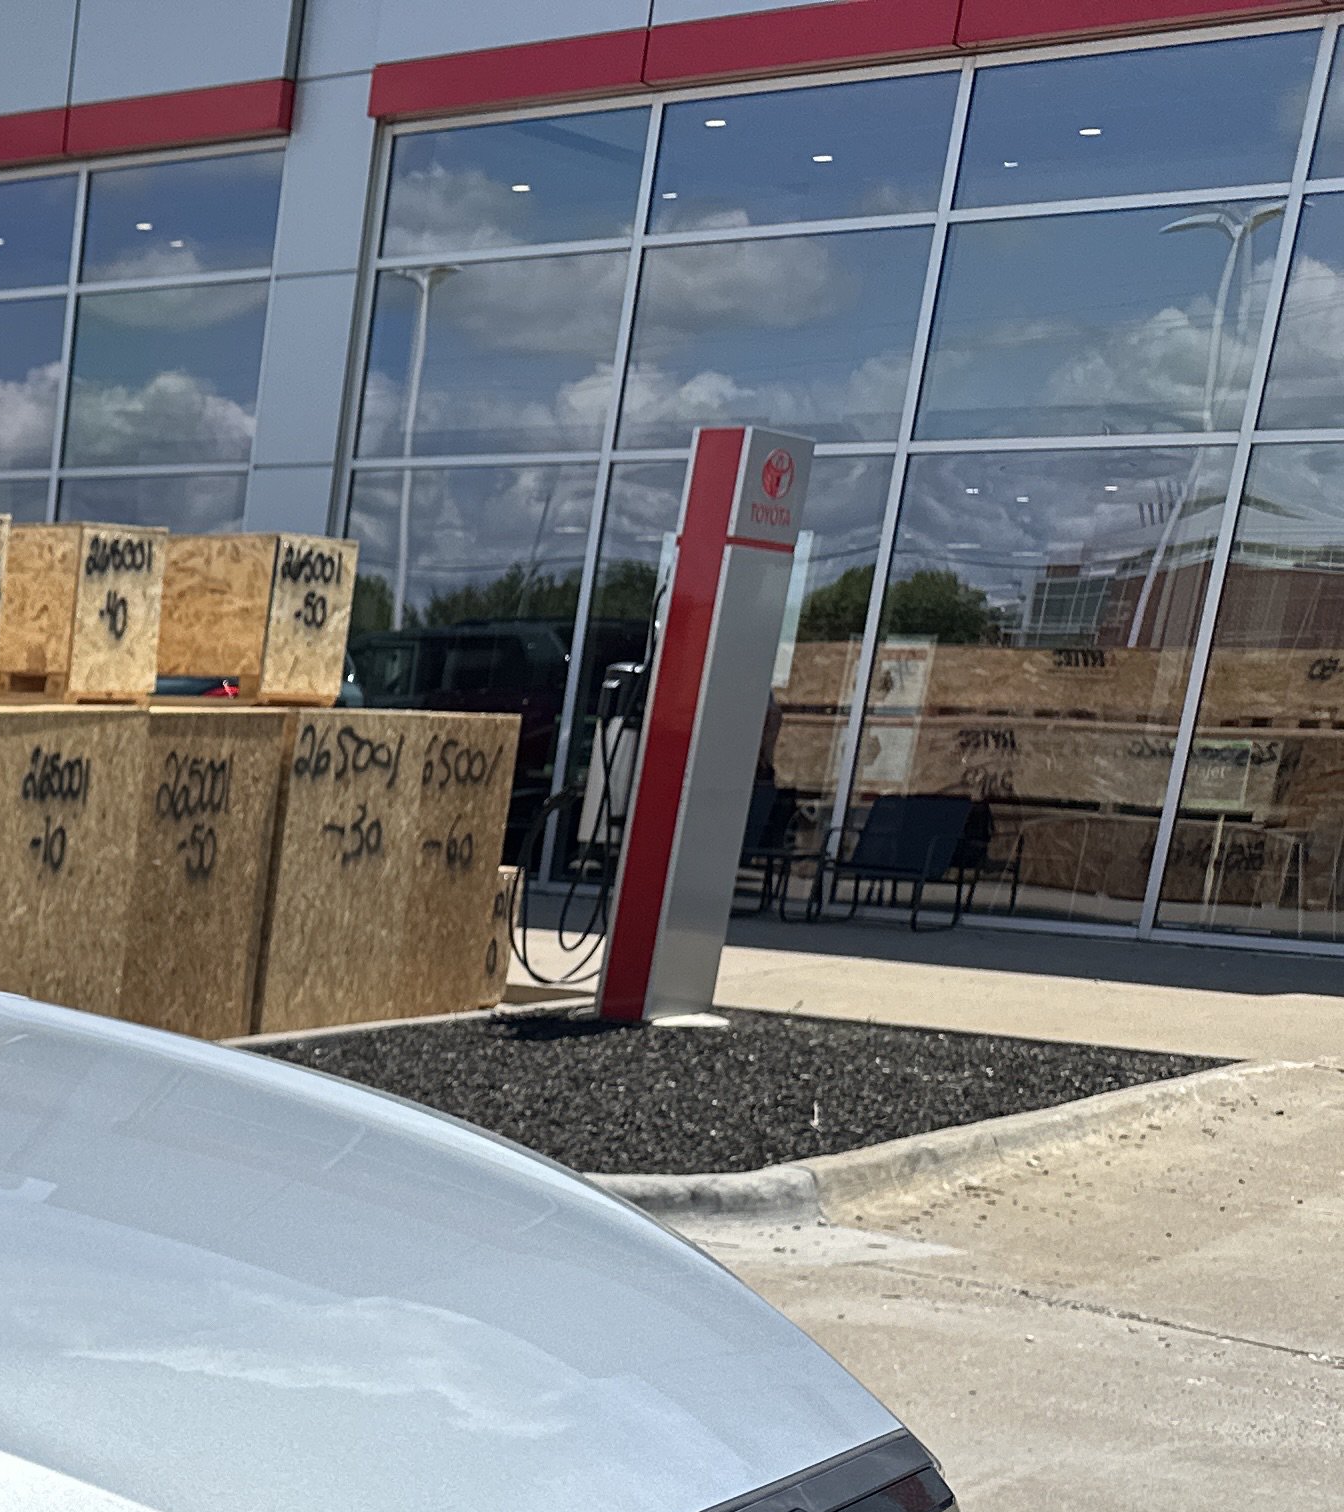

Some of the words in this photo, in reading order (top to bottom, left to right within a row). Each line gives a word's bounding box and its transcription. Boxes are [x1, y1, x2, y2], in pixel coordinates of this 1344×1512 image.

[751, 502, 792, 526] TOYOTA
[29, 816, 66, 873] -10
[177, 823, 217, 880] -50
[323, 802, 382, 866] -30
[422, 813, 474, 867] -60
